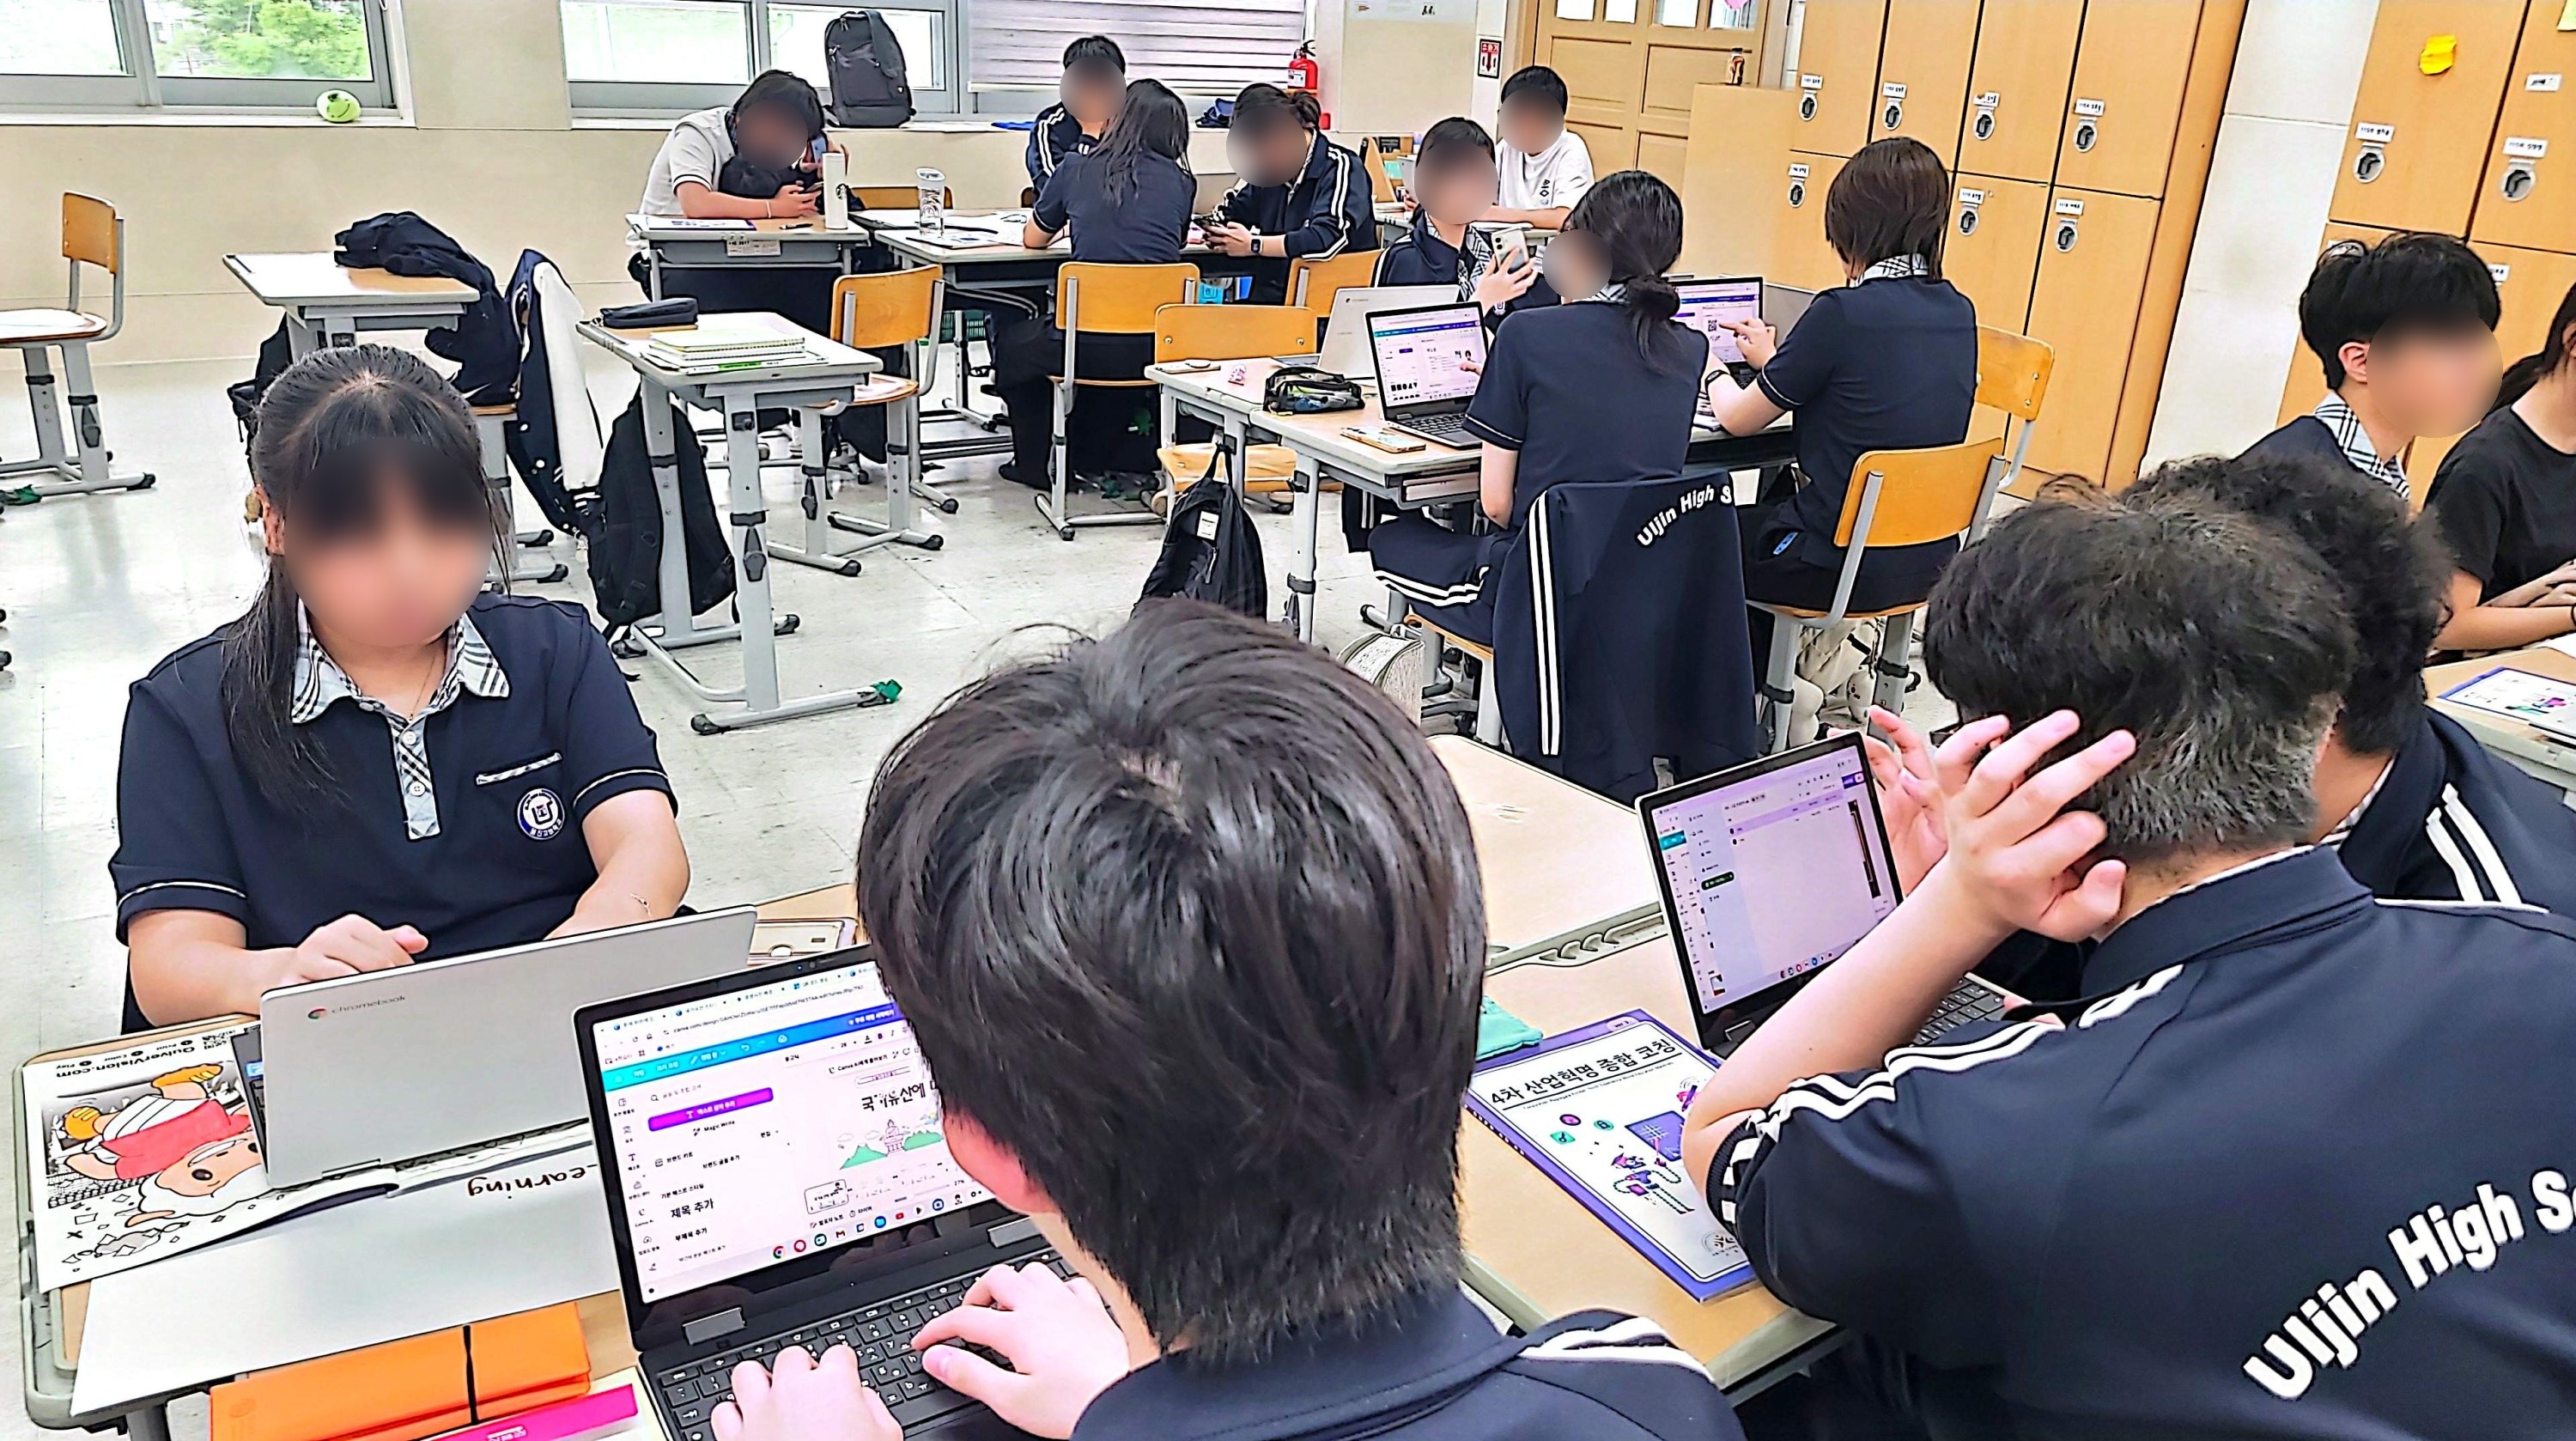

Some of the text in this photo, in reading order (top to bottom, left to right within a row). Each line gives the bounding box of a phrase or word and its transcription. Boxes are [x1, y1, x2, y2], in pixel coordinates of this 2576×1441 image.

[1637, 508, 1677, 546] Uljin
[1680, 484, 1715, 514] High
[331, 995, 405, 1013] chromebook
[56, 1046, 196, 1079] QuiverVision.com
[1491, 1086, 1525, 1105] 4차
[1525, 1063, 1600, 1095] 산업혁명
[1597, 1052, 1637, 1073] 종합
[1635, 1038, 1677, 1060] 코칭
[467, 1164, 598, 1200] earning
[671, 1198, 714, 1219] 제목 추가
[695, 1226, 708, 1237] 추가
[2242, 1170, 2576, 1400] Uljin High S
